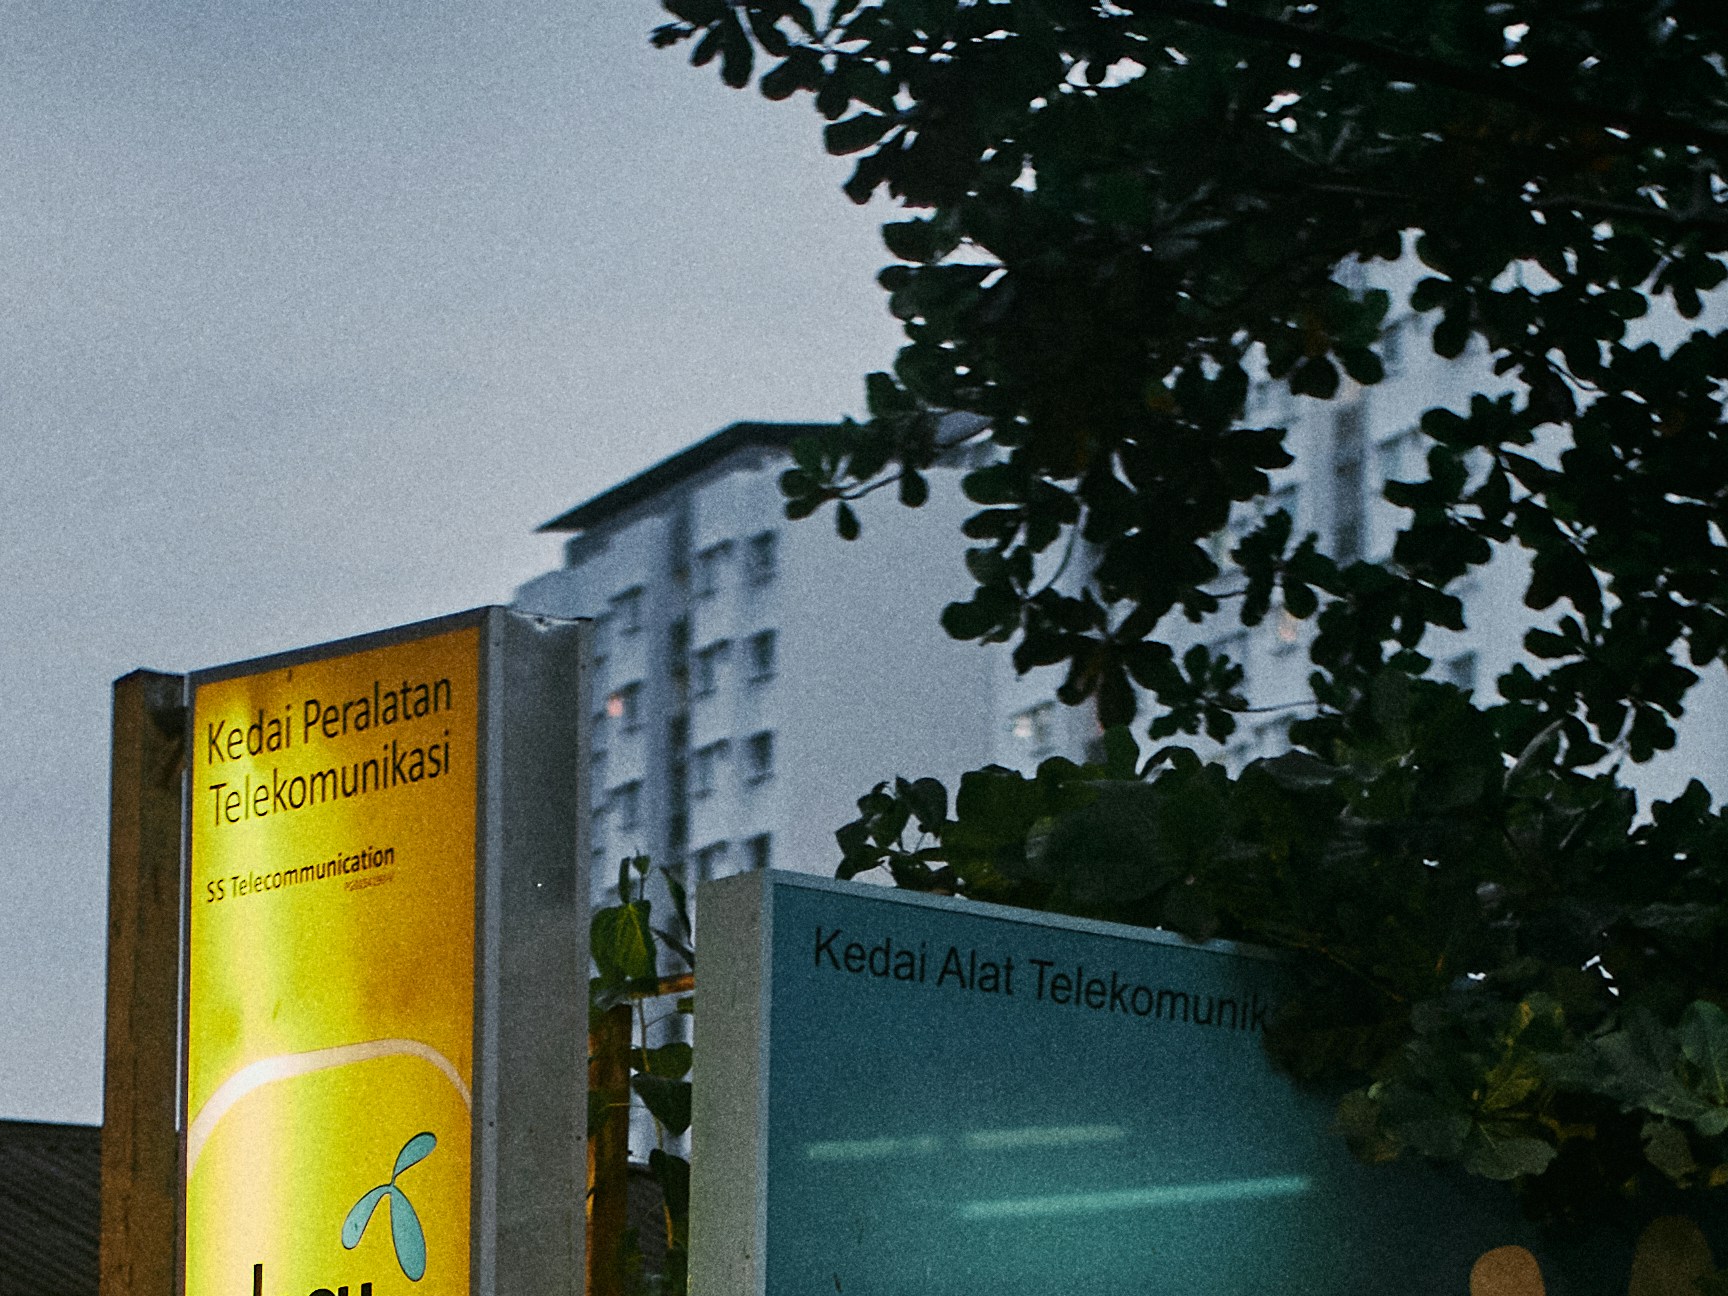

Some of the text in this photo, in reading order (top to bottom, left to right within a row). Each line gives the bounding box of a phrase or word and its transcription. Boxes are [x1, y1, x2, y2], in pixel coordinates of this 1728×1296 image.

[207, 675, 452, 765] Kedai Peralatan
[209, 730, 451, 826] Telekomunikasi
[206, 880, 225, 904] SS
[231, 845, 395, 896] Telecommunication
[813, 926, 1269, 1033] Kedai Alat Telekomunik
